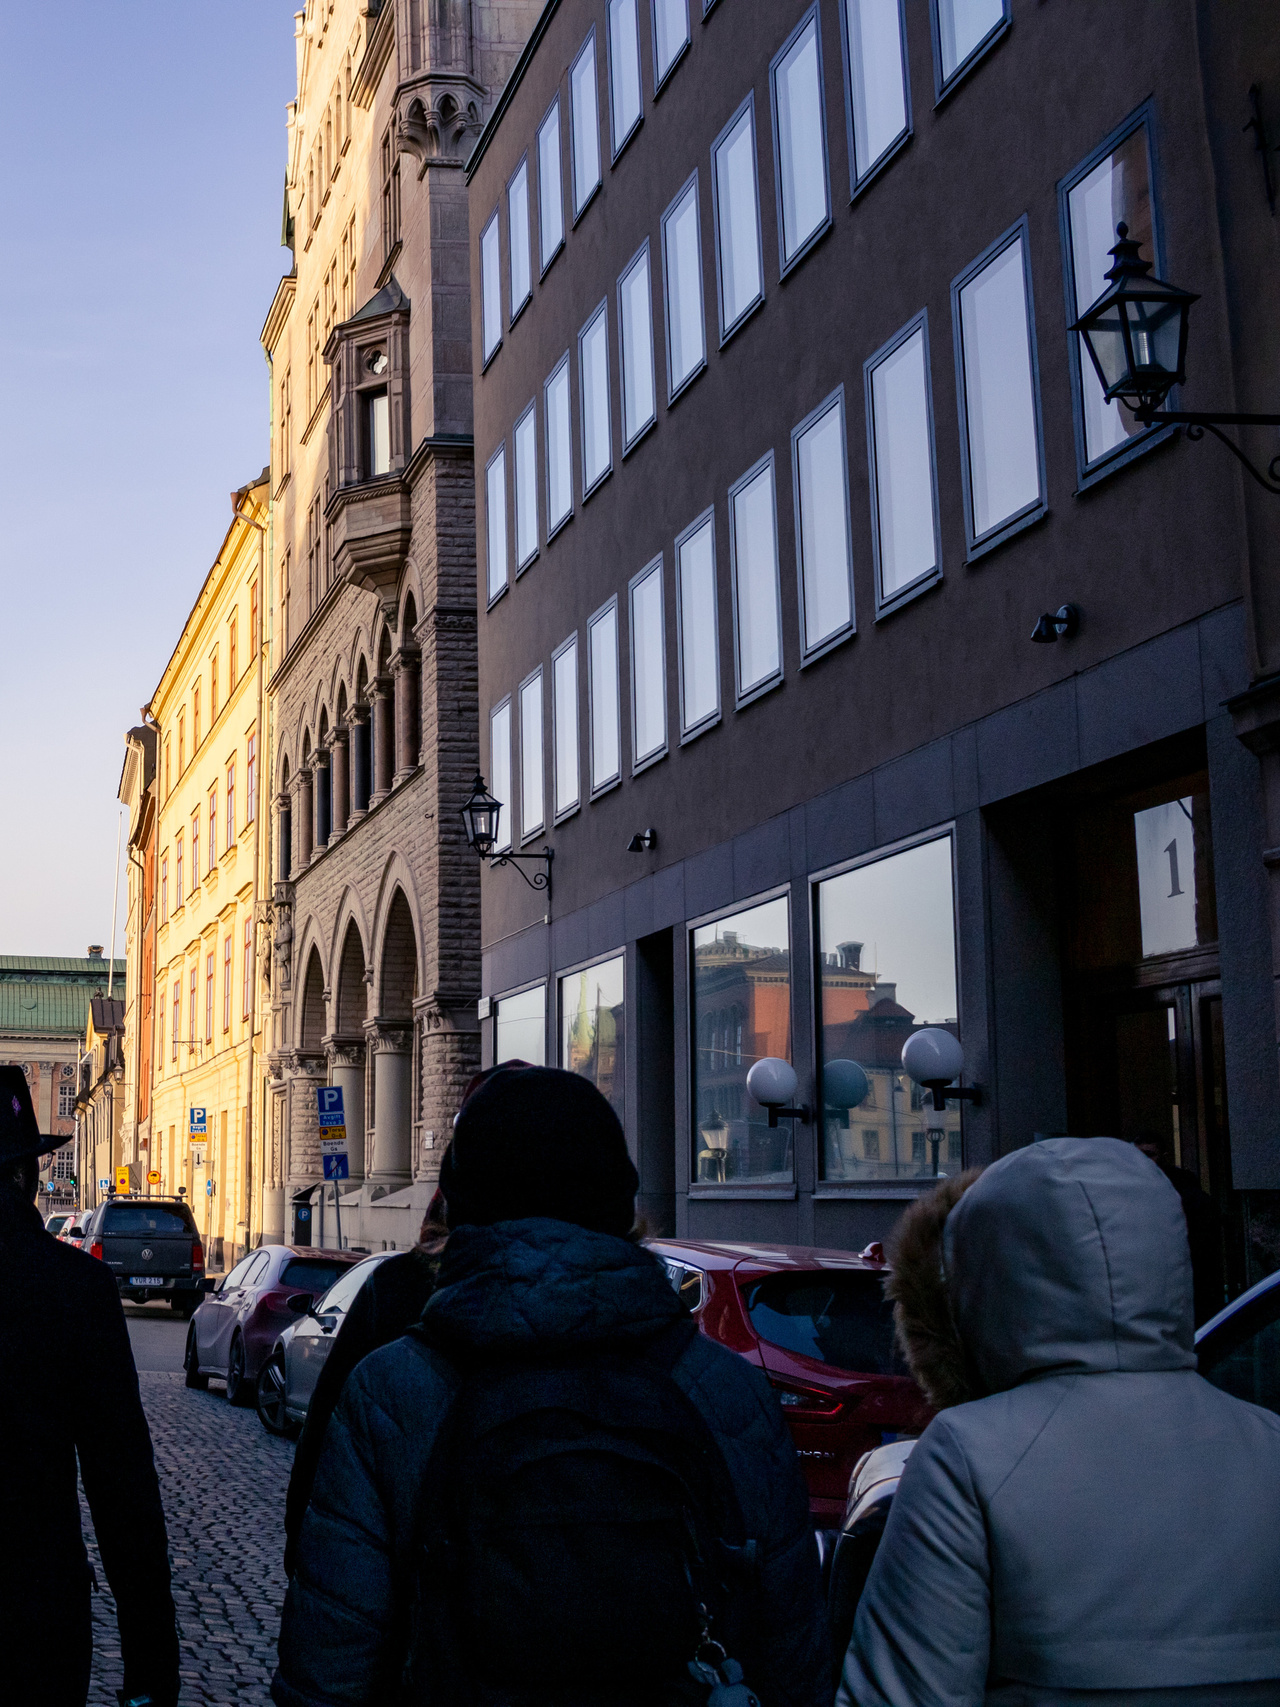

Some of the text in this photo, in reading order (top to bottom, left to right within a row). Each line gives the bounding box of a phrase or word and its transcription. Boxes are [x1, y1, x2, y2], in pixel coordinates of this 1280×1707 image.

[1163, 838, 1185, 898] 1
[324, 1089, 338, 1110] P
[194, 1109, 204, 1123] P
[301, 1211, 308, 1219] P
